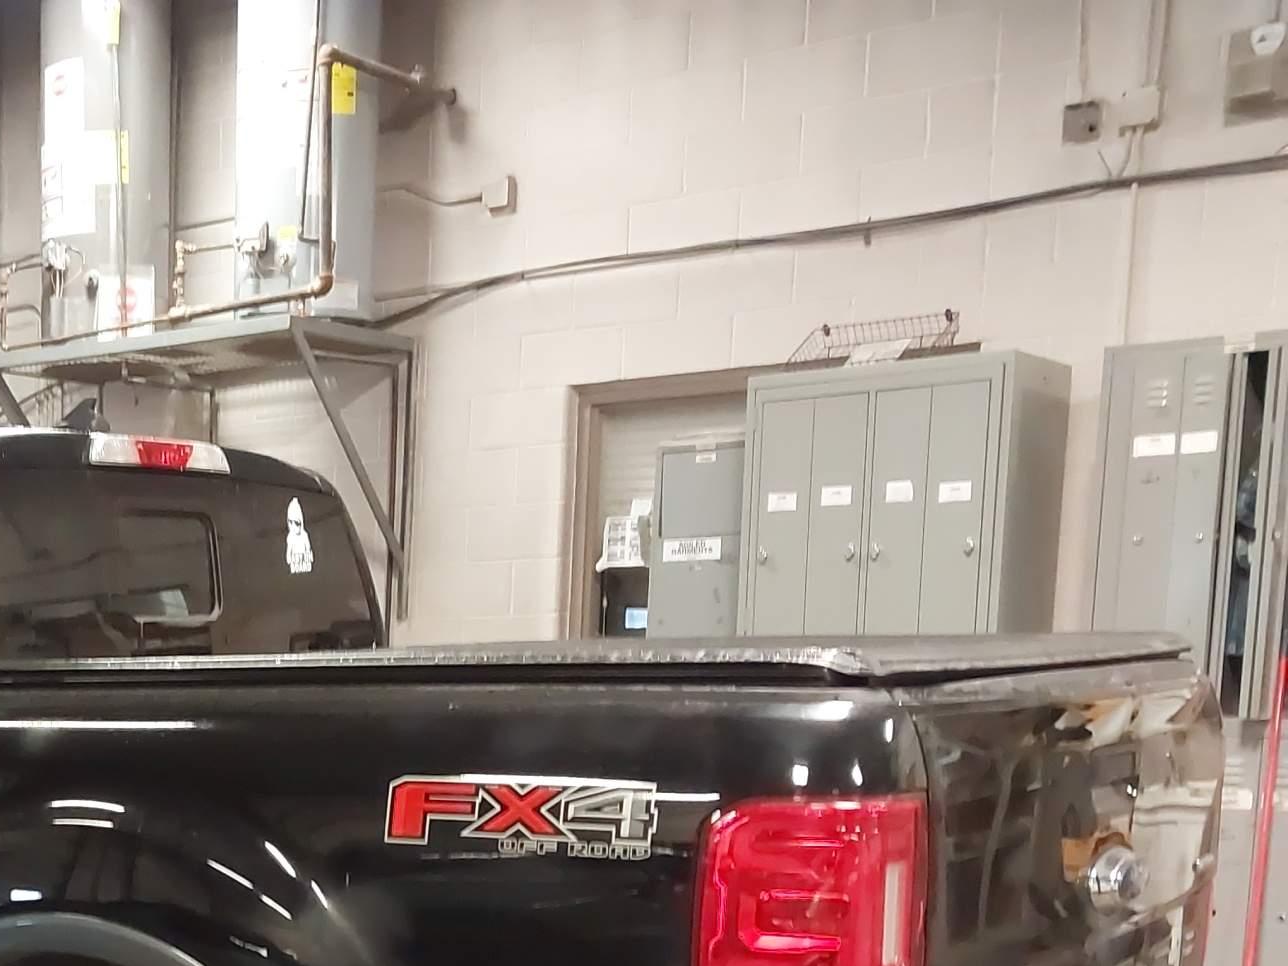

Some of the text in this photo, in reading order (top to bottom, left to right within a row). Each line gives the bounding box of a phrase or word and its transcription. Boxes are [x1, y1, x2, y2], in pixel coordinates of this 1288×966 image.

[384, 774, 658, 845] FX4
[498, 837, 651, 860] OFF ROAD
